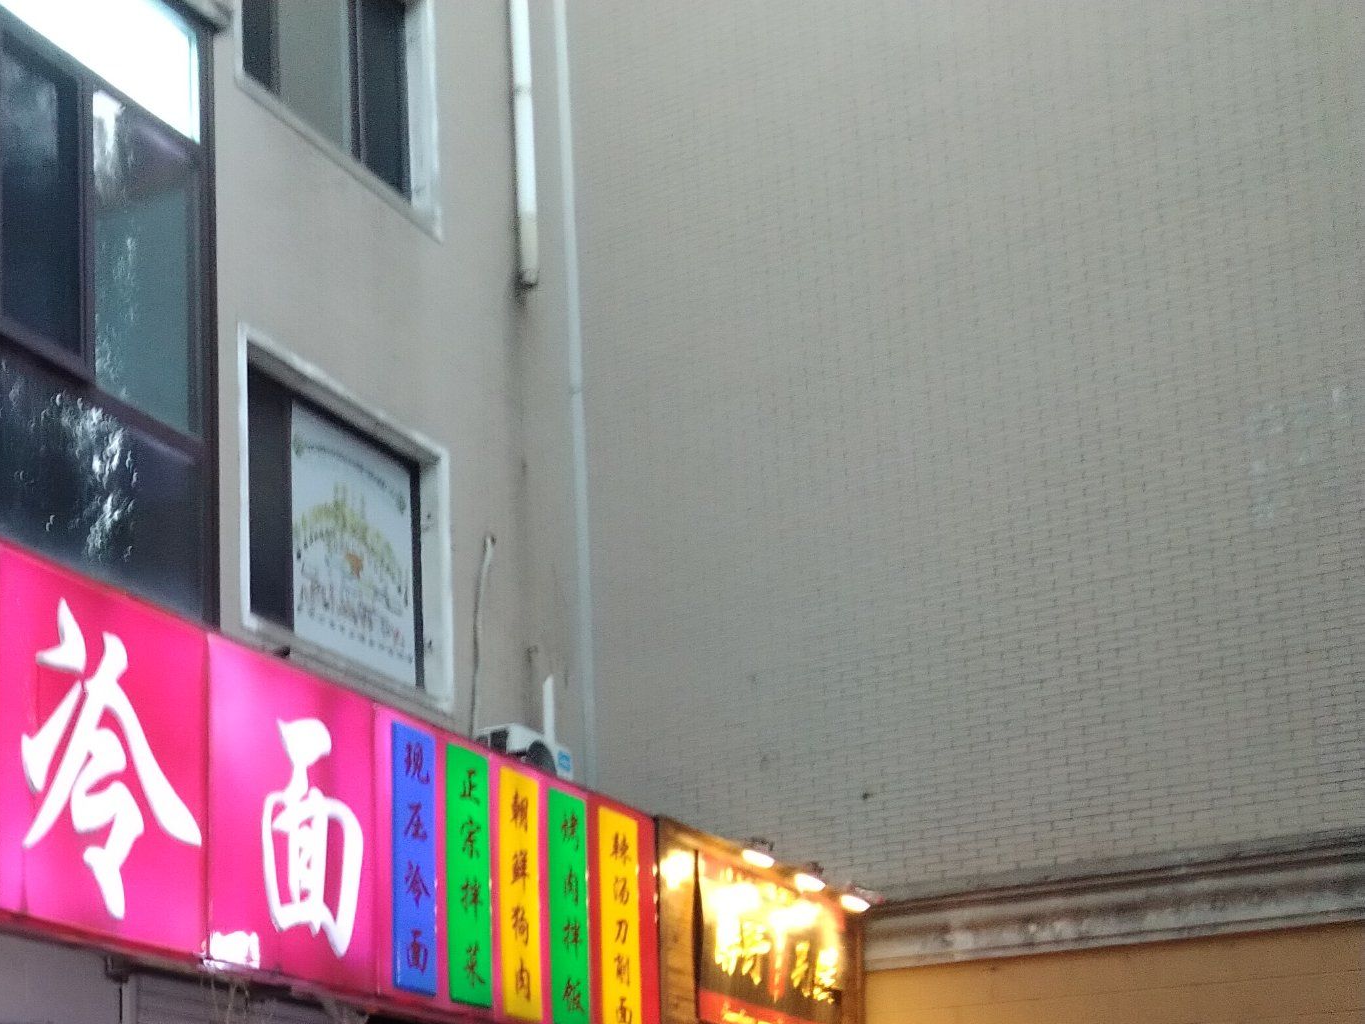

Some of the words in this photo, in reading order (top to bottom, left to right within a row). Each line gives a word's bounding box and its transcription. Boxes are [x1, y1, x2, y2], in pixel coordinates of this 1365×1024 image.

[460, 768, 486, 988] 正宗拌菜
[510, 788, 531, 1003] 朝鲜狗肉
